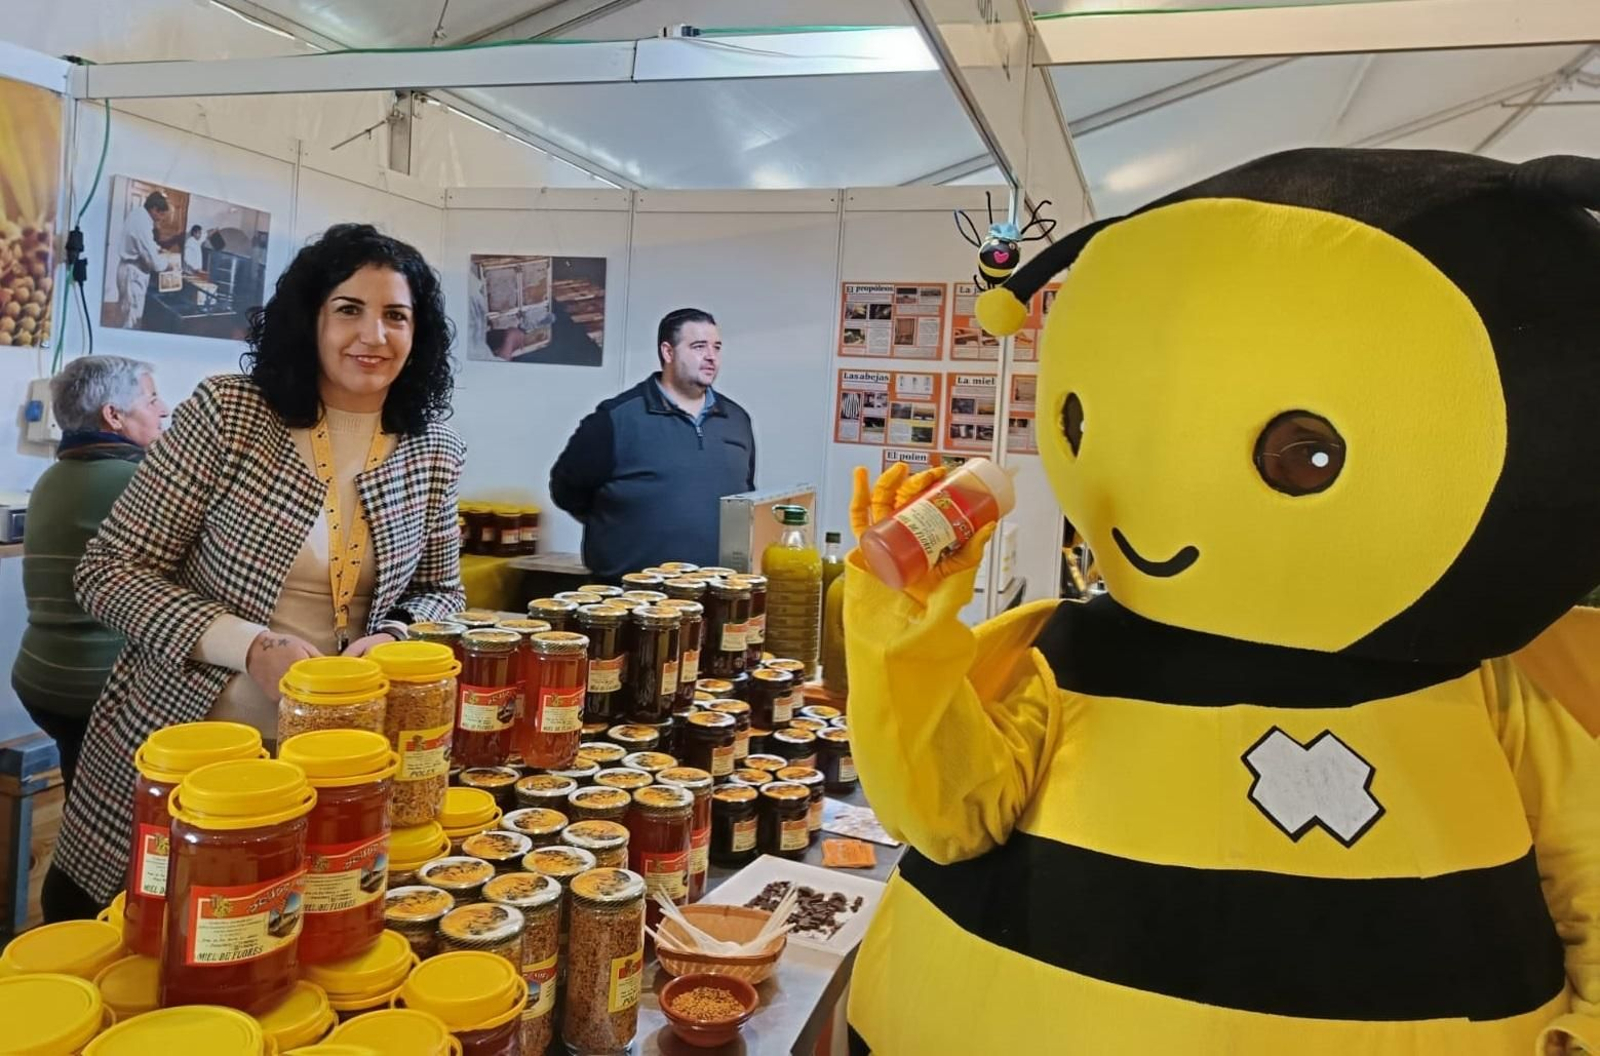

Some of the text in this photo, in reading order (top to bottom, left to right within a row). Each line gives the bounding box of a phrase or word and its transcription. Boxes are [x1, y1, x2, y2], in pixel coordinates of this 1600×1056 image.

[957, 377, 996, 385] La miel
[887, 451, 927, 461] El polen
[197, 945, 263, 961] MIEL DE FLORES
